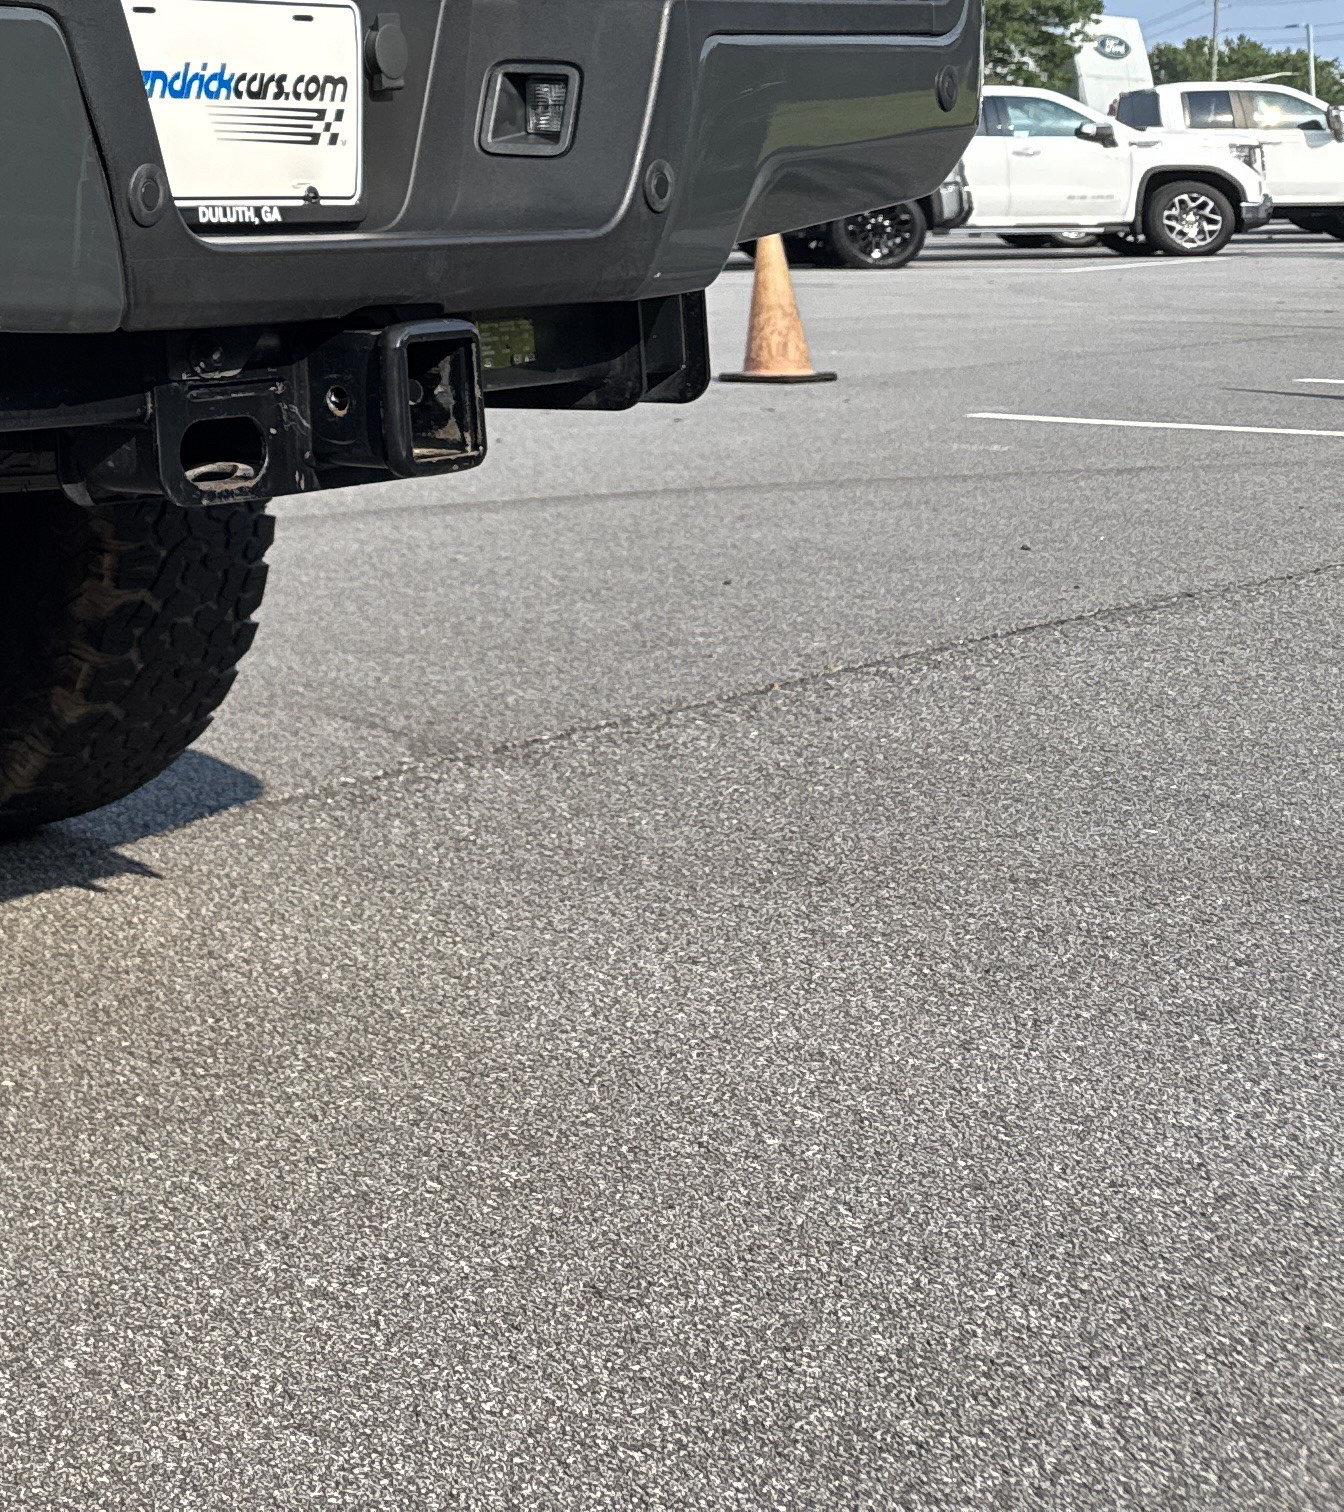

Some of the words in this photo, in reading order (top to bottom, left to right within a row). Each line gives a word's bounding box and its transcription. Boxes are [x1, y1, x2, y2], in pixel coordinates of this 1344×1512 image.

[140, 61, 349, 103] ndrickcars.com
[198, 206, 260, 225] DULUTH,
[261, 206, 282, 222] GA
